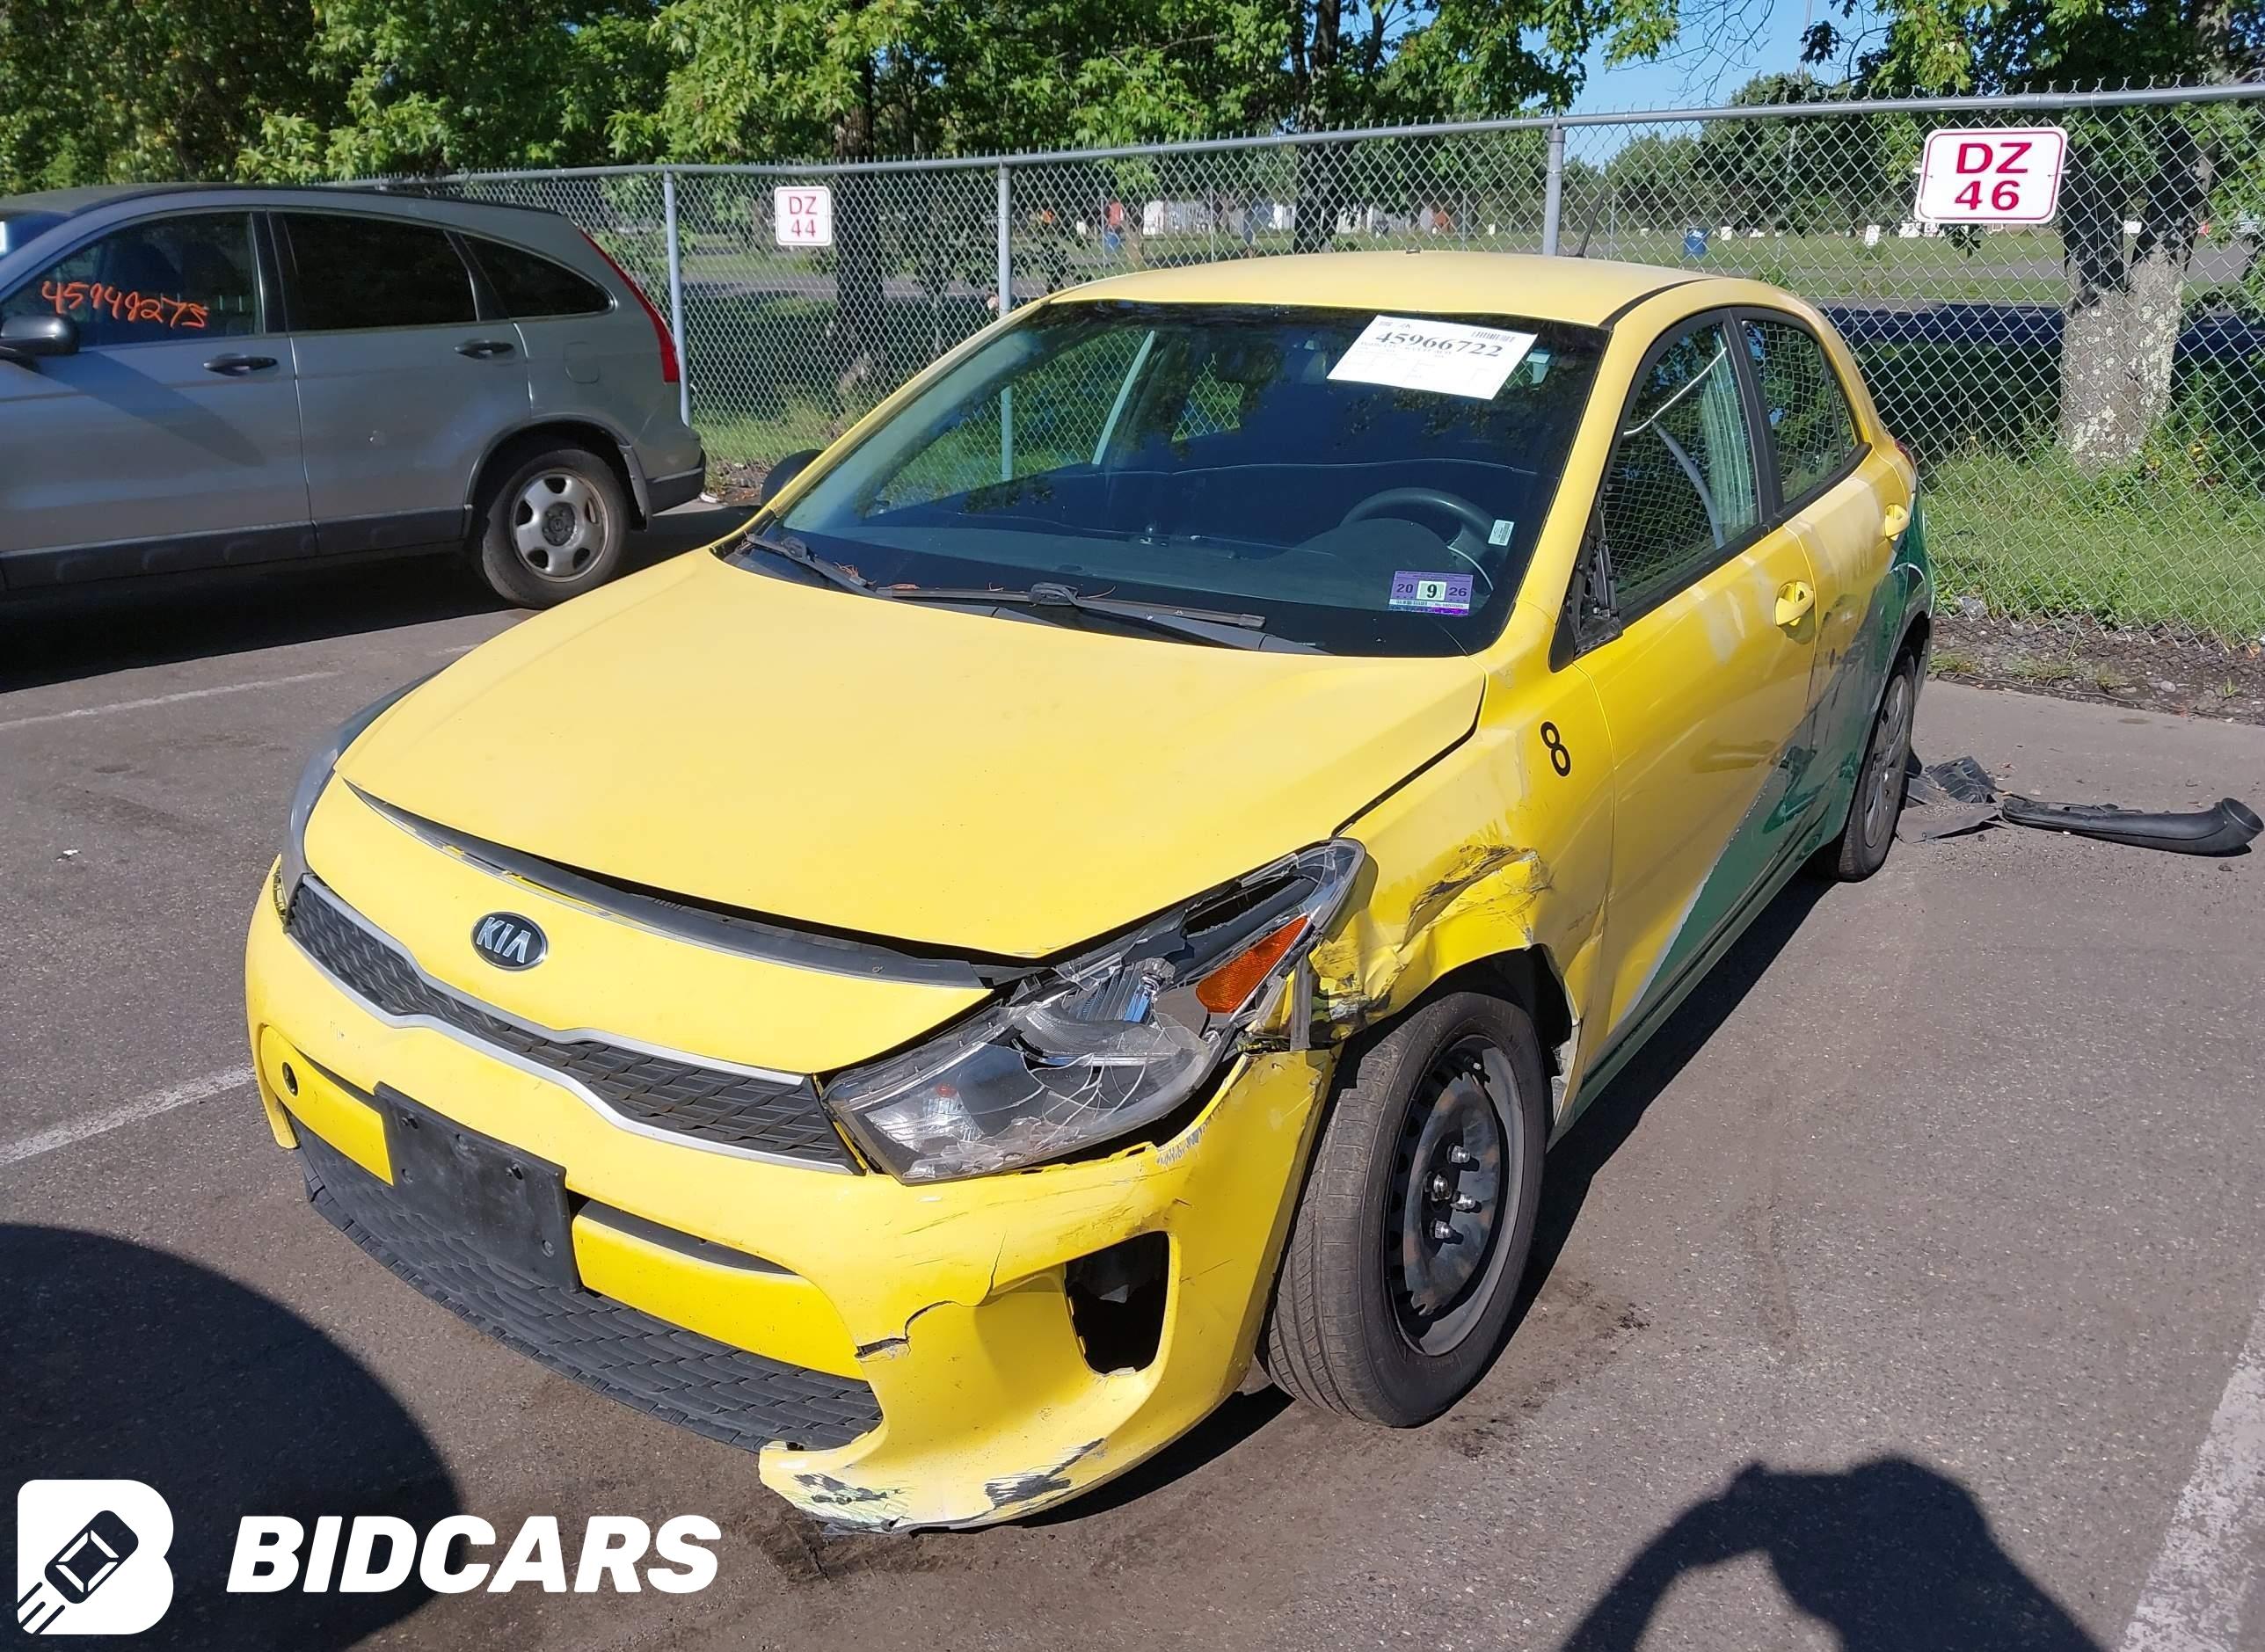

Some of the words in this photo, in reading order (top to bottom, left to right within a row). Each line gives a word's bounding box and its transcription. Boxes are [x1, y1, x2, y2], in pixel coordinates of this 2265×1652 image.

[1955, 142, 2033, 174] DZ
[789, 196, 818, 215] DZ
[1954, 179, 2021, 211] 46
[790, 219, 817, 237] 44
[1375, 331, 1504, 357] 45966722
[1396, 584, 1414, 593] 20
[1426, 584, 1438, 599] 9
[1448, 586, 1468, 597] 26
[1540, 721, 1571, 777] 8
[476, 916, 531, 964] KIA
